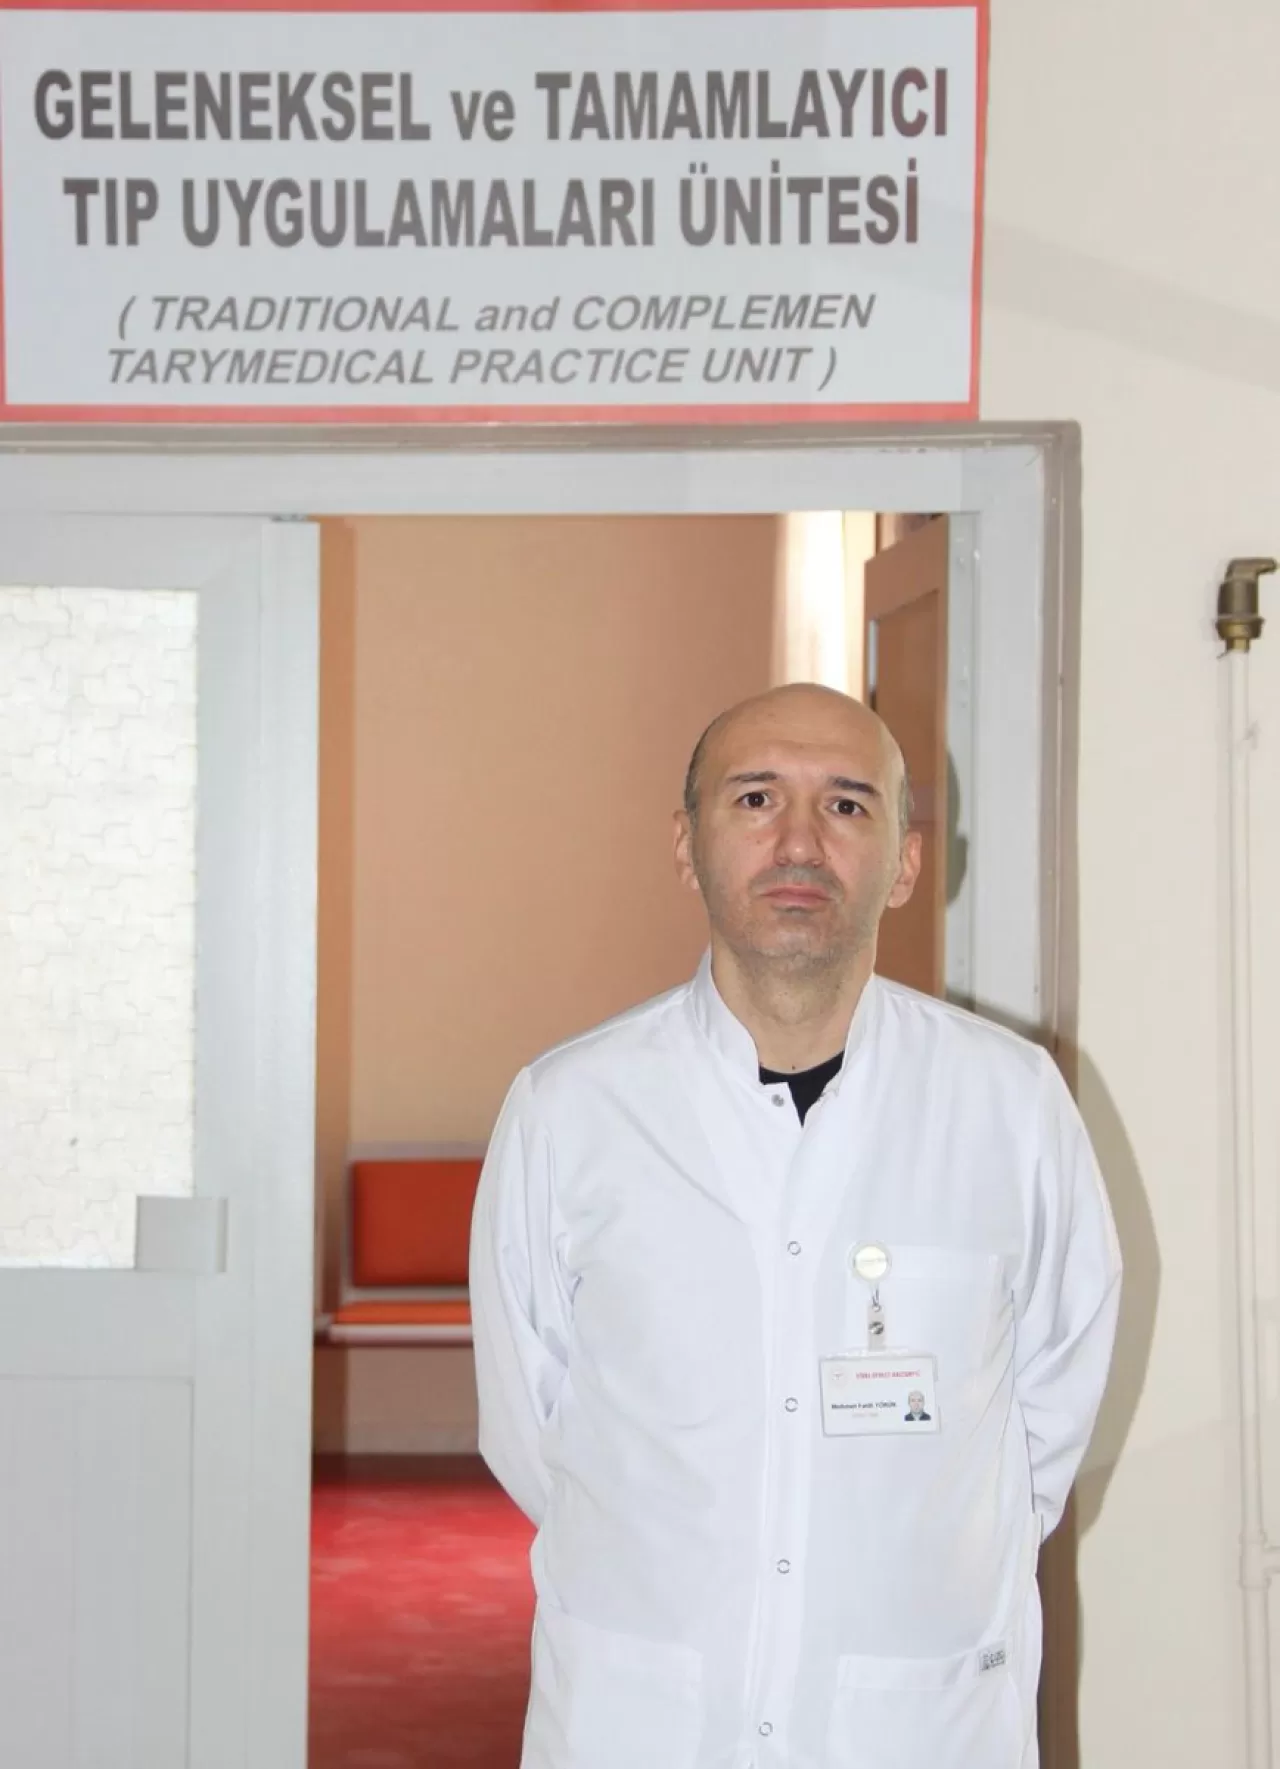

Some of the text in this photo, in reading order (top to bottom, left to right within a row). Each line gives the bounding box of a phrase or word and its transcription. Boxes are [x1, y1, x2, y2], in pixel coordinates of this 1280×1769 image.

[33, 66, 949, 143] GELENEKSEL ve TAMAMLAYICI
[62, 157, 919, 249] TIP UYGULAMALARI ÜNİTESİ
[151, 294, 460, 333] TRADITIONAL
[474, 295, 561, 333] and
[572, 293, 877, 331] COMPLEMEN
[107, 348, 434, 385] TARYMEDICAL
[450, 347, 690, 384] PRACTICE
[701, 346, 815, 384] UNIT
